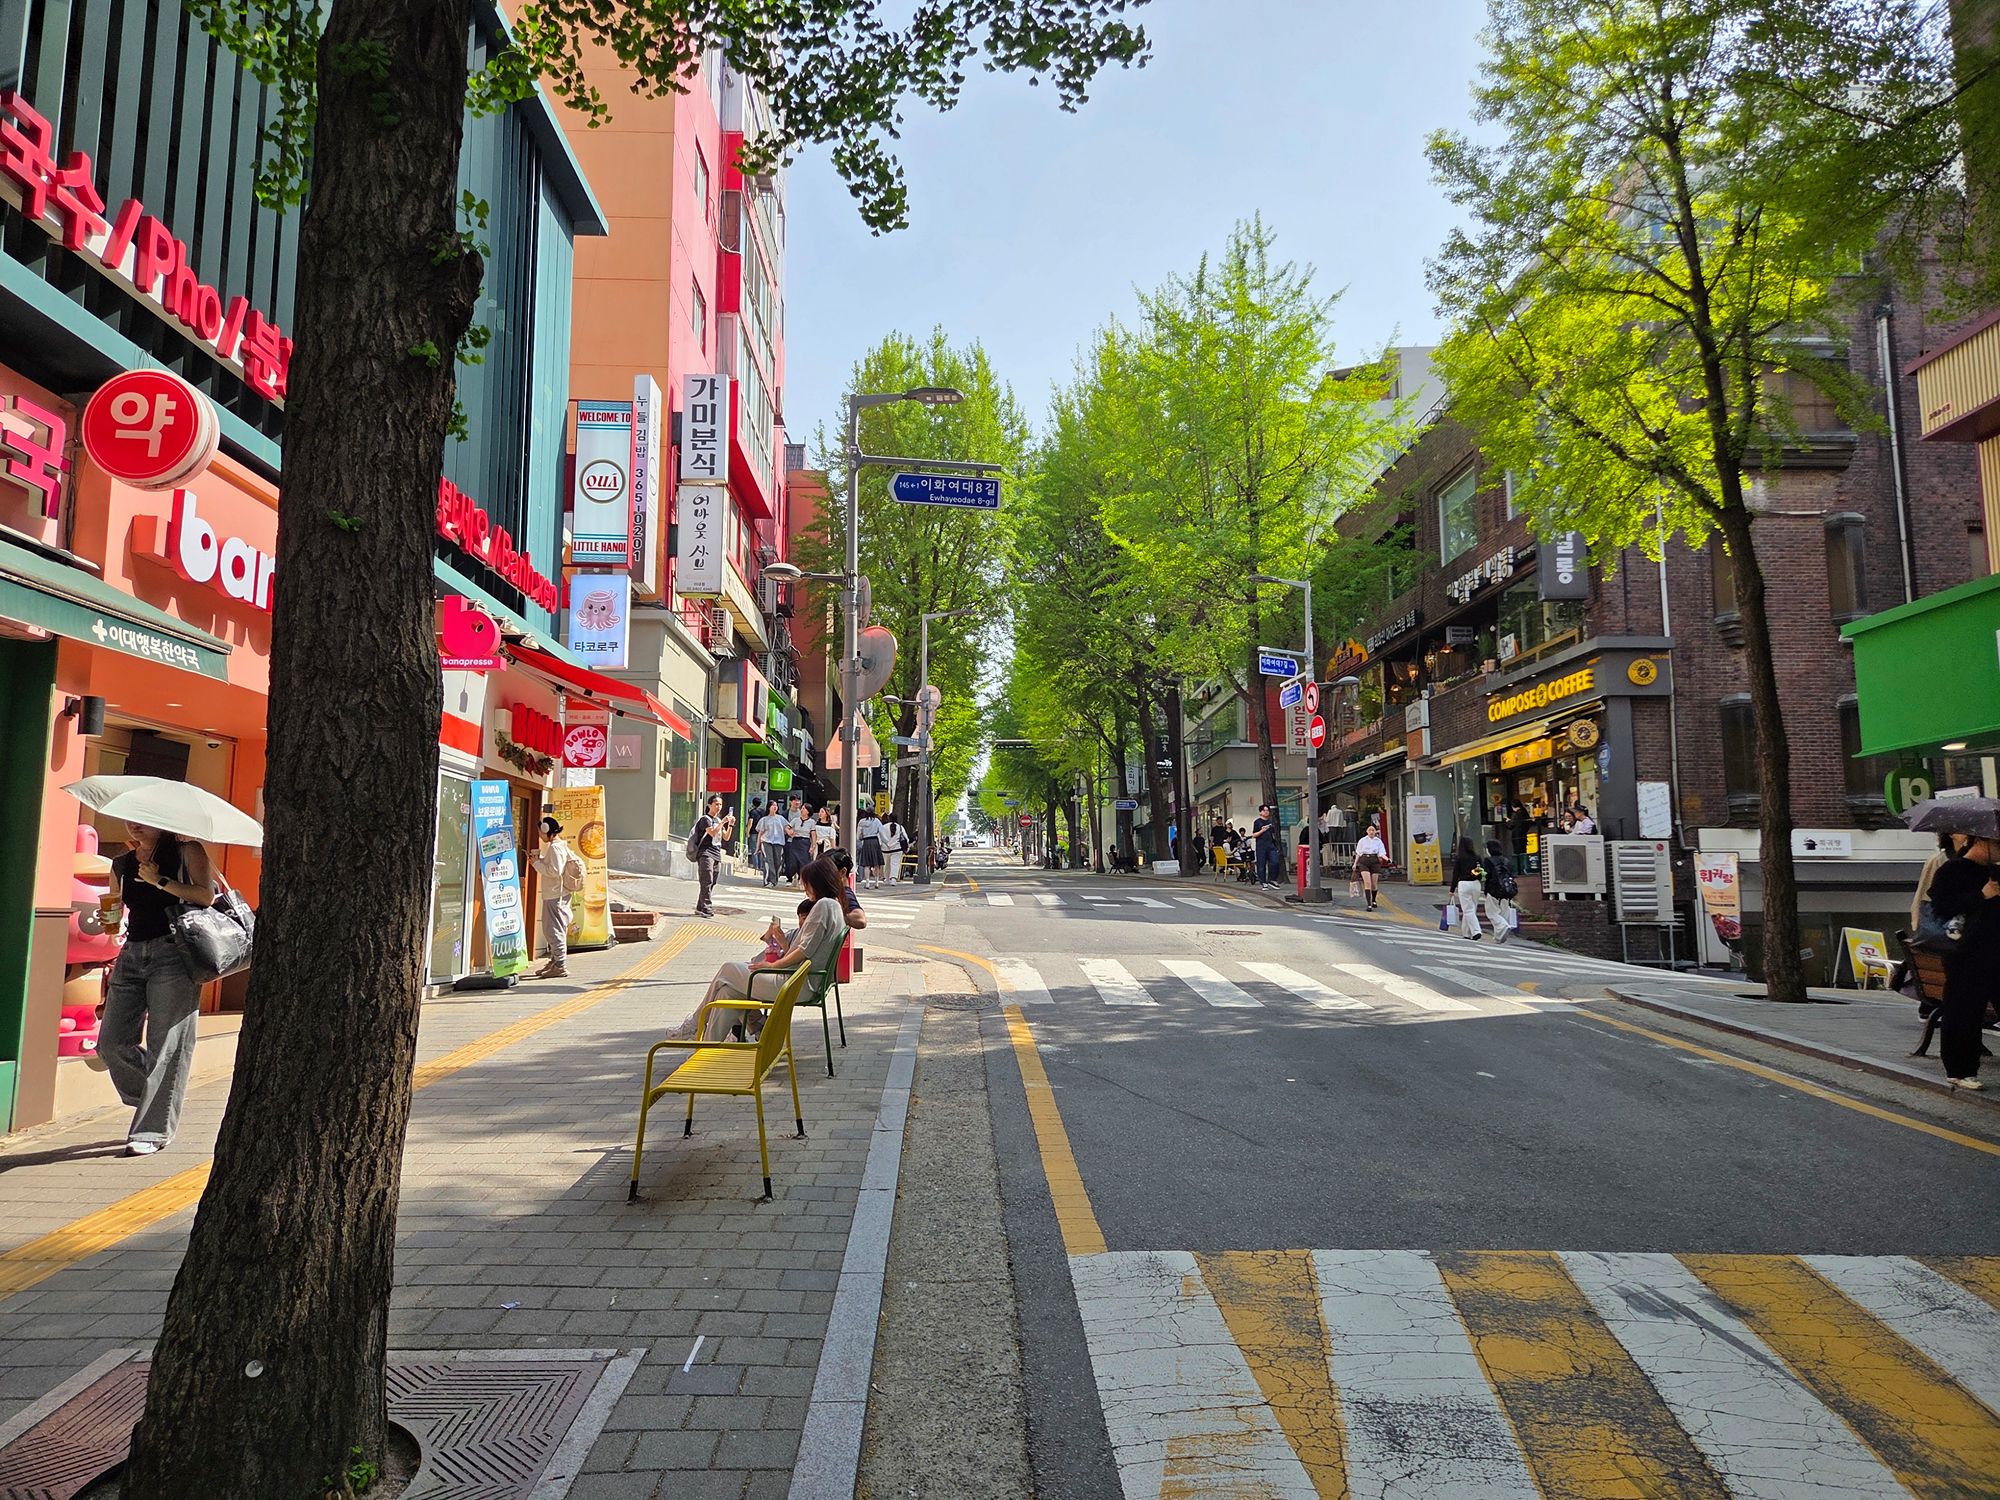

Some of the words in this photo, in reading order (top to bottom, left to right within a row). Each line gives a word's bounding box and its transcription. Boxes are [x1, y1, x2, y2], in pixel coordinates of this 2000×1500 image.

[110, 391, 177, 458] 약
[579, 411, 619, 423] WELCOME
[621, 412, 631, 423] TO
[690, 377, 720, 476] 가미분식
[920, 478, 996, 496] 이화여대8길
[929, 493, 976, 505] Ewhayeodae
[977, 497, 995, 507] 8-gil
[692, 493, 710, 540] 어바웃
[573, 541, 600, 552] LITTLE
[601, 542, 626, 552] HANOI
[688, 544, 710, 571] 샵
[109, 626, 201, 670] 이대행복한약국
[574, 641, 619, 653] 타코로쿠
[442, 657, 494, 668] banapresso
[1487, 690, 1537, 723] COMPOSE
[1547, 668, 1595, 701] COFFEE
[1572, 721, 1597, 733] COMPOSE
[565, 729, 599, 748] BOWLO
[1573, 737, 1595, 747] COFFEE
